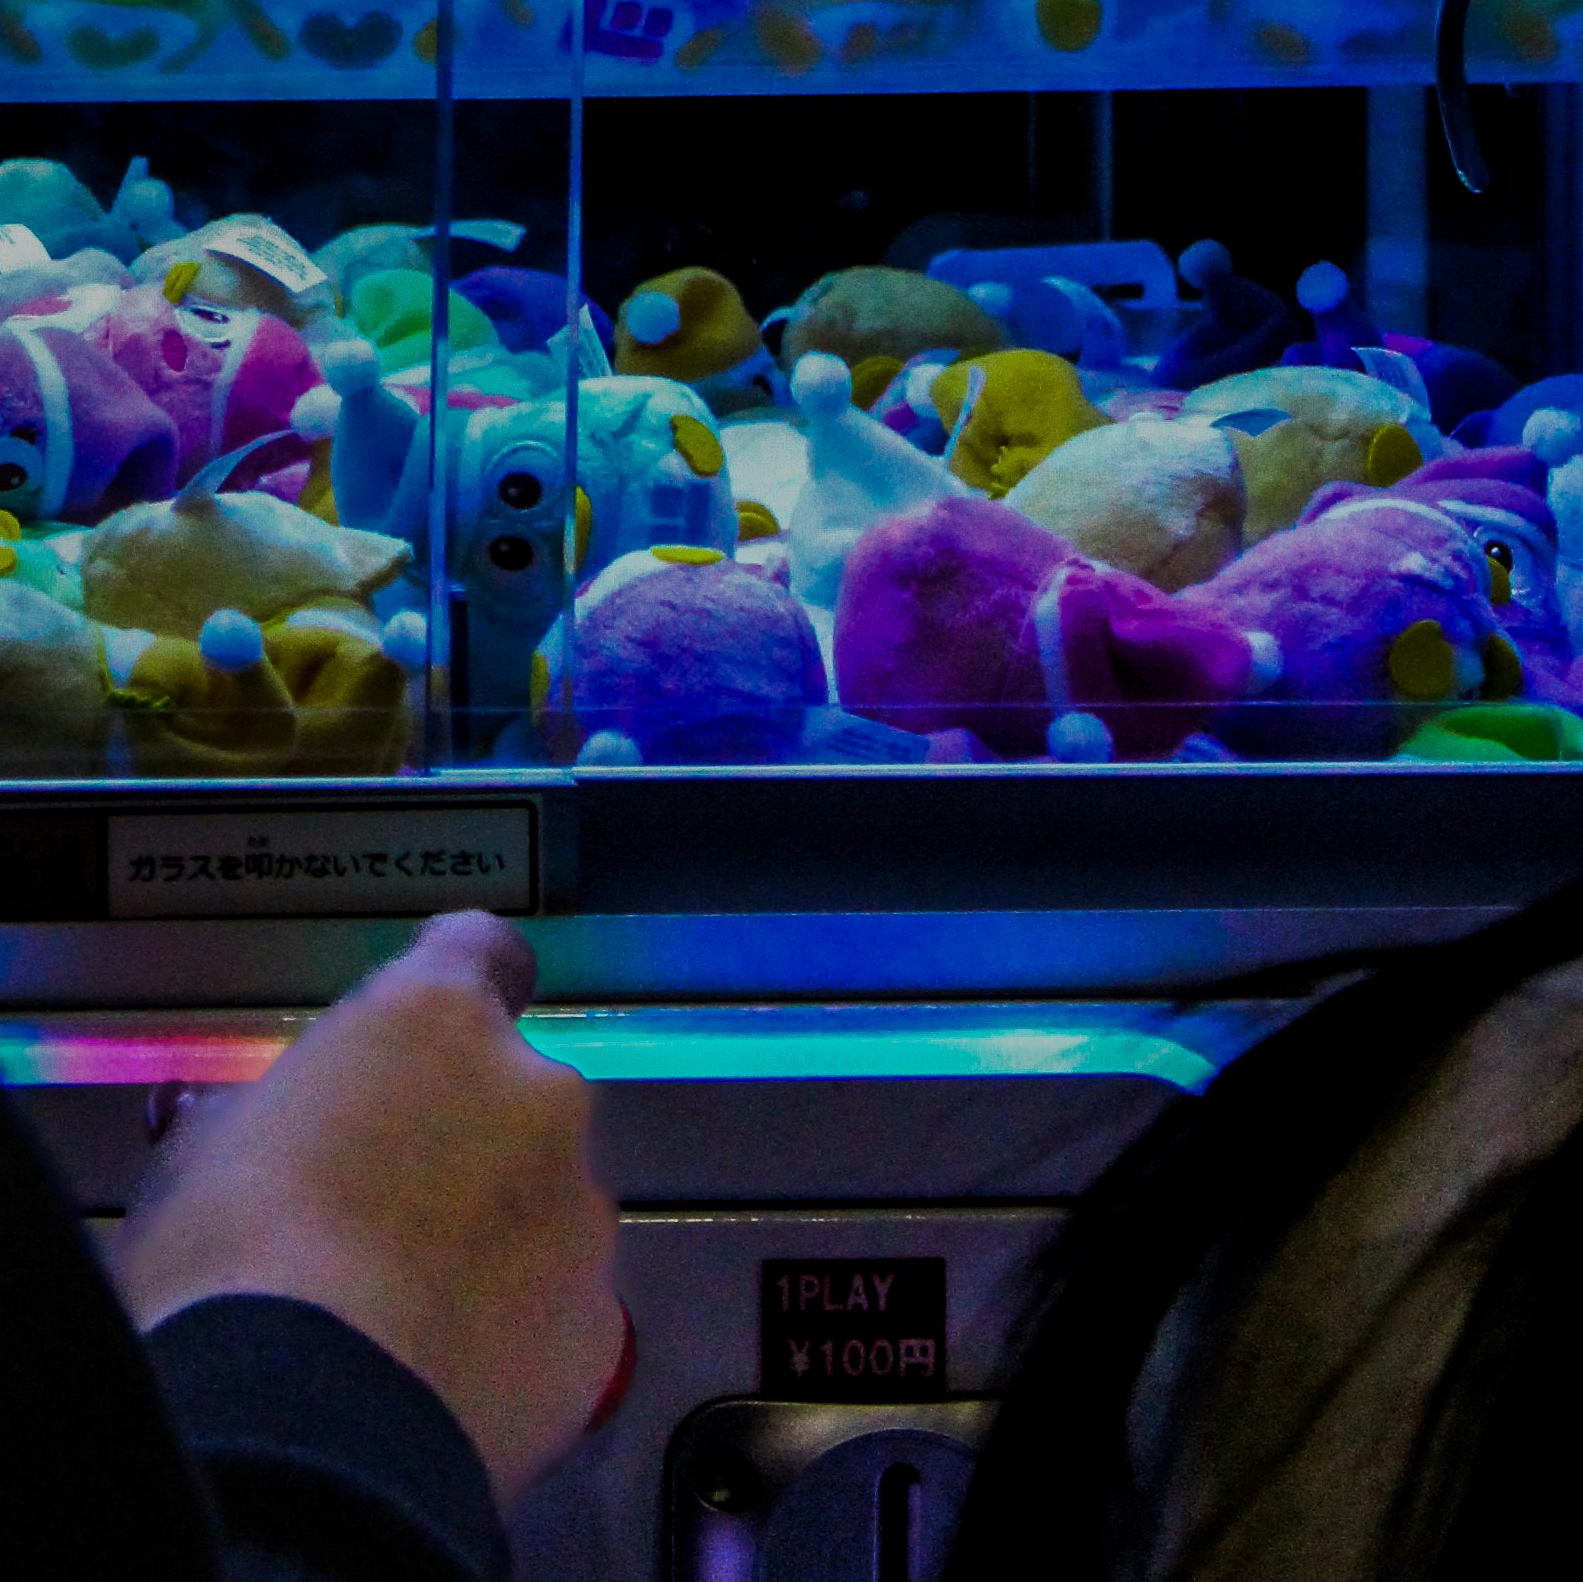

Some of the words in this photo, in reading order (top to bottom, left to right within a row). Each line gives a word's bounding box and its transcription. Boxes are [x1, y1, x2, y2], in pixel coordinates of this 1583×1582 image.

[129, 849, 505, 882] ガラスを叩かないでください
[774, 1272, 896, 1314] 1PLAY
[785, 1337, 937, 1379] ¥100円
